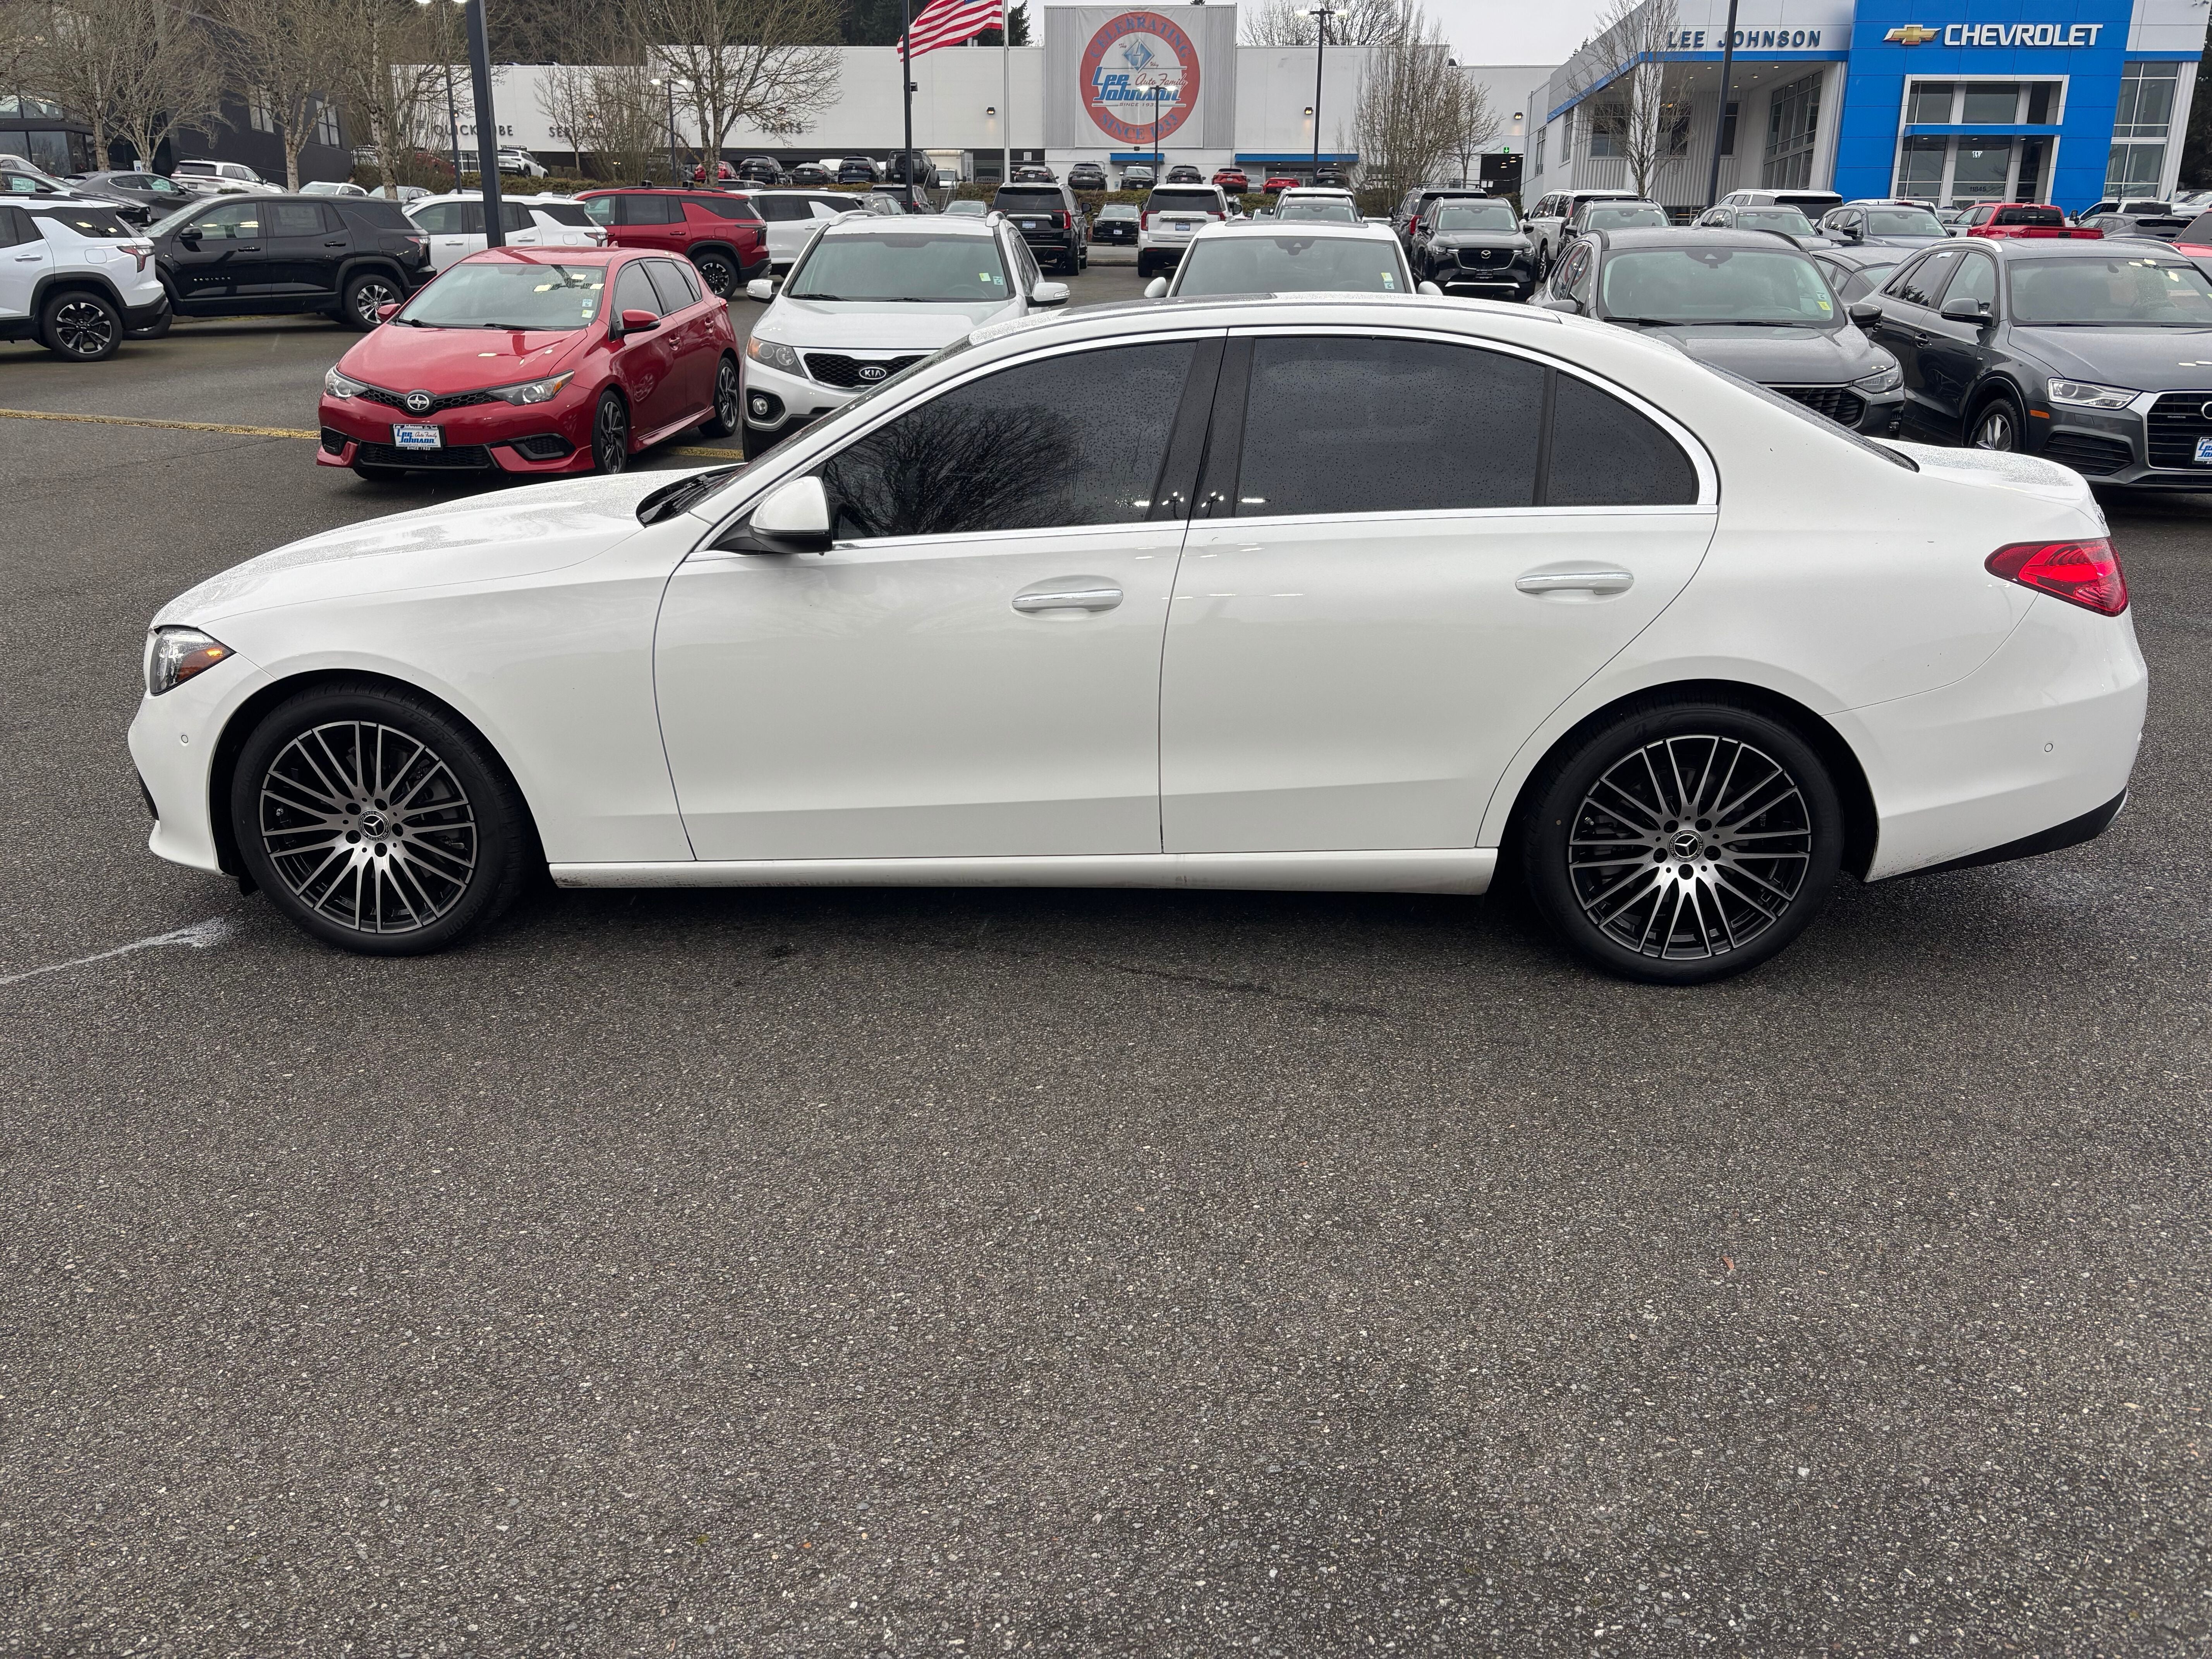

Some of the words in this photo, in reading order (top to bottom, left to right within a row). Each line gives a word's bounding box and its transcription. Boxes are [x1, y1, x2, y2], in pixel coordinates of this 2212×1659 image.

[1090, 17, 1191, 58] CELEBRATING
[1668, 31, 1705, 48] LEE
[1718, 30, 1821, 48] JOHNSON
[1944, 24, 2104, 46] CHEVROLET
[1092, 66, 1131, 86] Lee
[1135, 73, 1157, 86] Auto
[1158, 73, 1188, 91] Family
[762, 122, 802, 134] PARTS
[1099, 114, 1145, 139] SINCE
[1150, 113, 1178, 139] 1933
[397, 428, 414, 437] Lee
